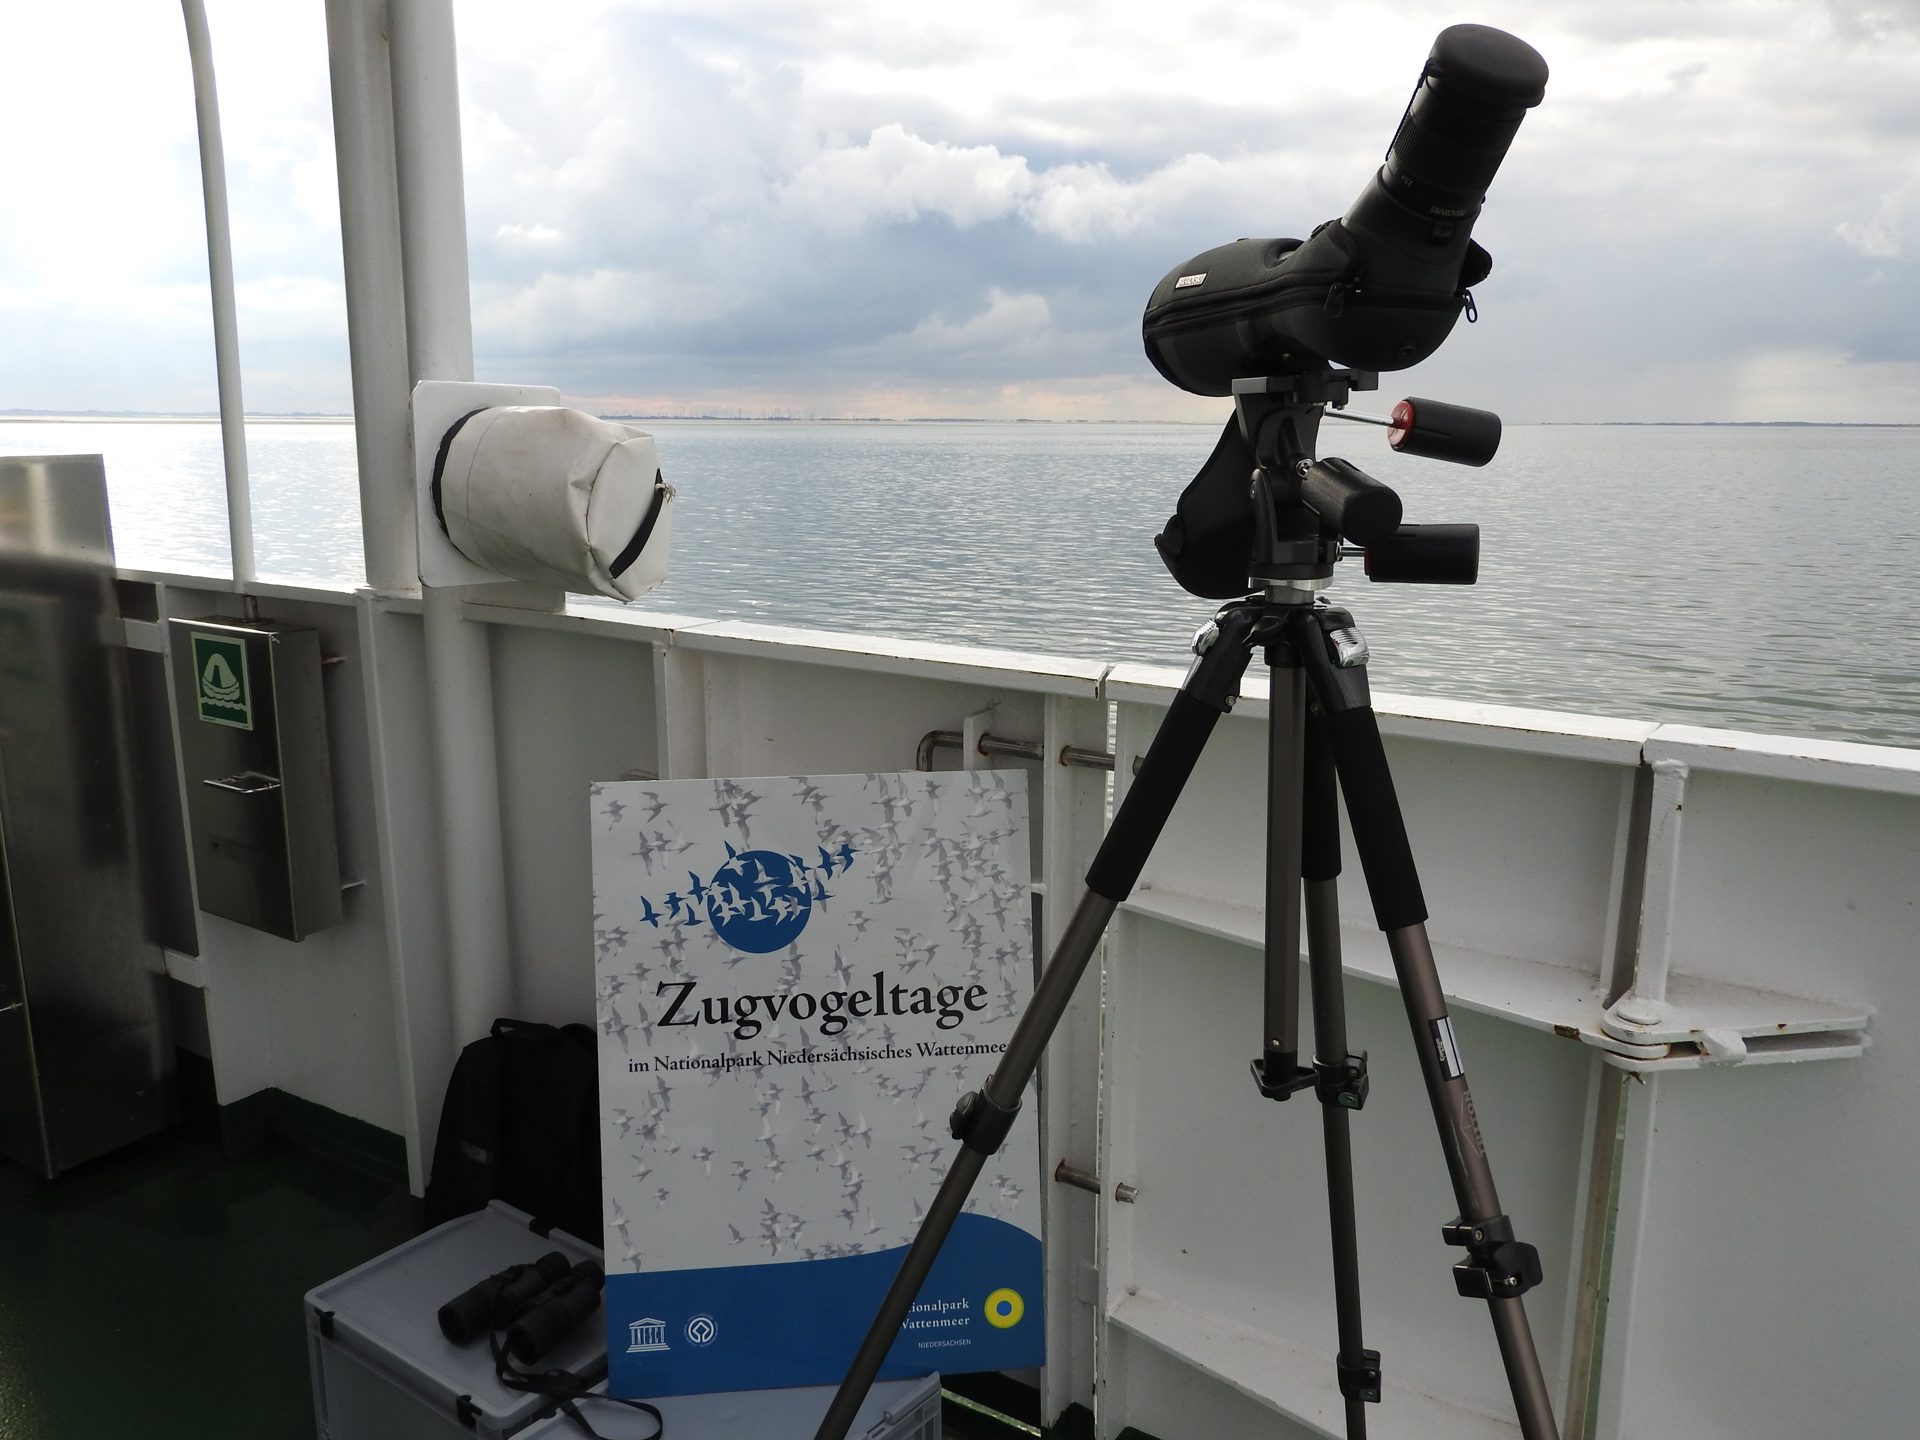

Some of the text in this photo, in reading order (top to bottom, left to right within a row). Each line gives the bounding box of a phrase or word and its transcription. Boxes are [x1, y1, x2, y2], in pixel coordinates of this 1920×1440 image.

[655, 971, 988, 1040] Zugvogeltage
[628, 1041, 1008, 1073] im Nationalpark Niedersächsisches Wattenmee
[908, 1298, 970, 1314] ionalpark
[631, 1326, 665, 1345] UNESCO
[918, 1339, 972, 1349] NIEDERSACHSEN
